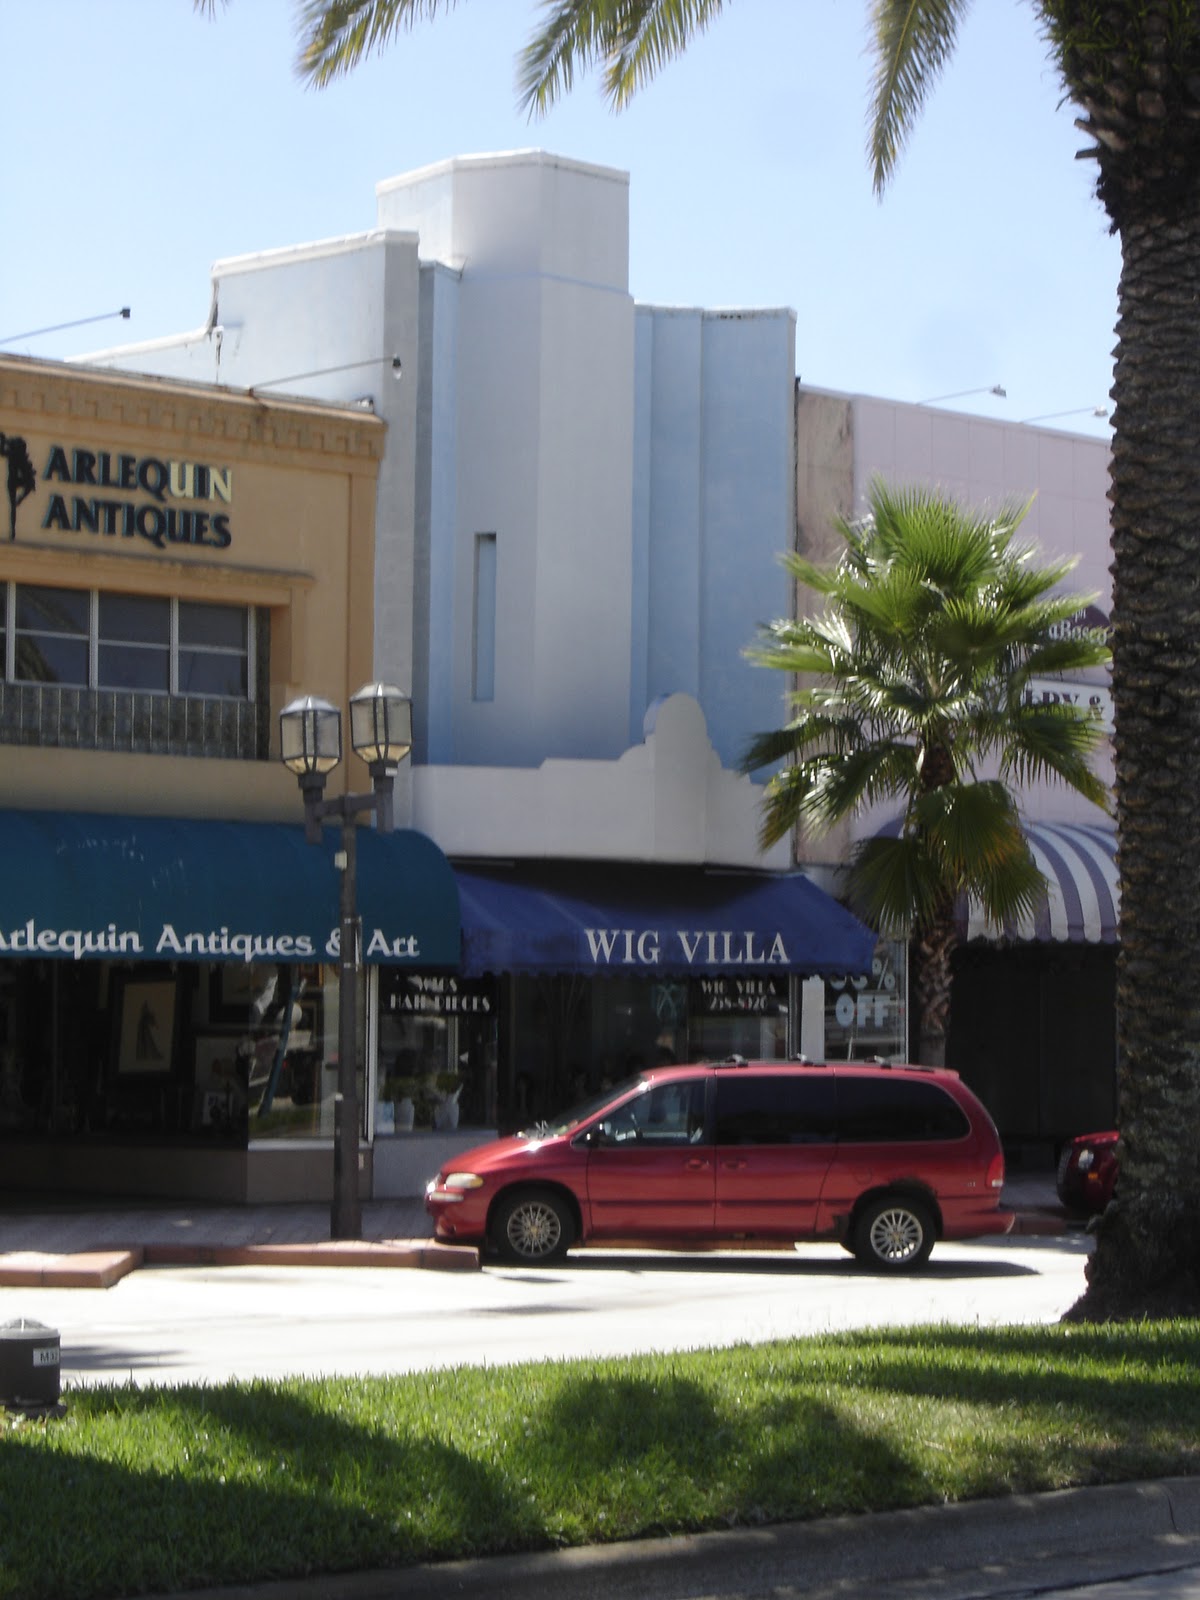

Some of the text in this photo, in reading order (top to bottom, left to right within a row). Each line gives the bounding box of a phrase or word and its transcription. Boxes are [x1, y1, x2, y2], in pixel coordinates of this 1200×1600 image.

[42, 445, 233, 503] ARLEQUIN
[41, 494, 233, 549] ANTIQUES
[156, 923, 316, 963] Antiques
[366, 928, 420, 958] Art
[584, 928, 791, 965] WIG VILLA
[736, 980, 777, 995] VILLA
[835, 992, 891, 1028] OFF
